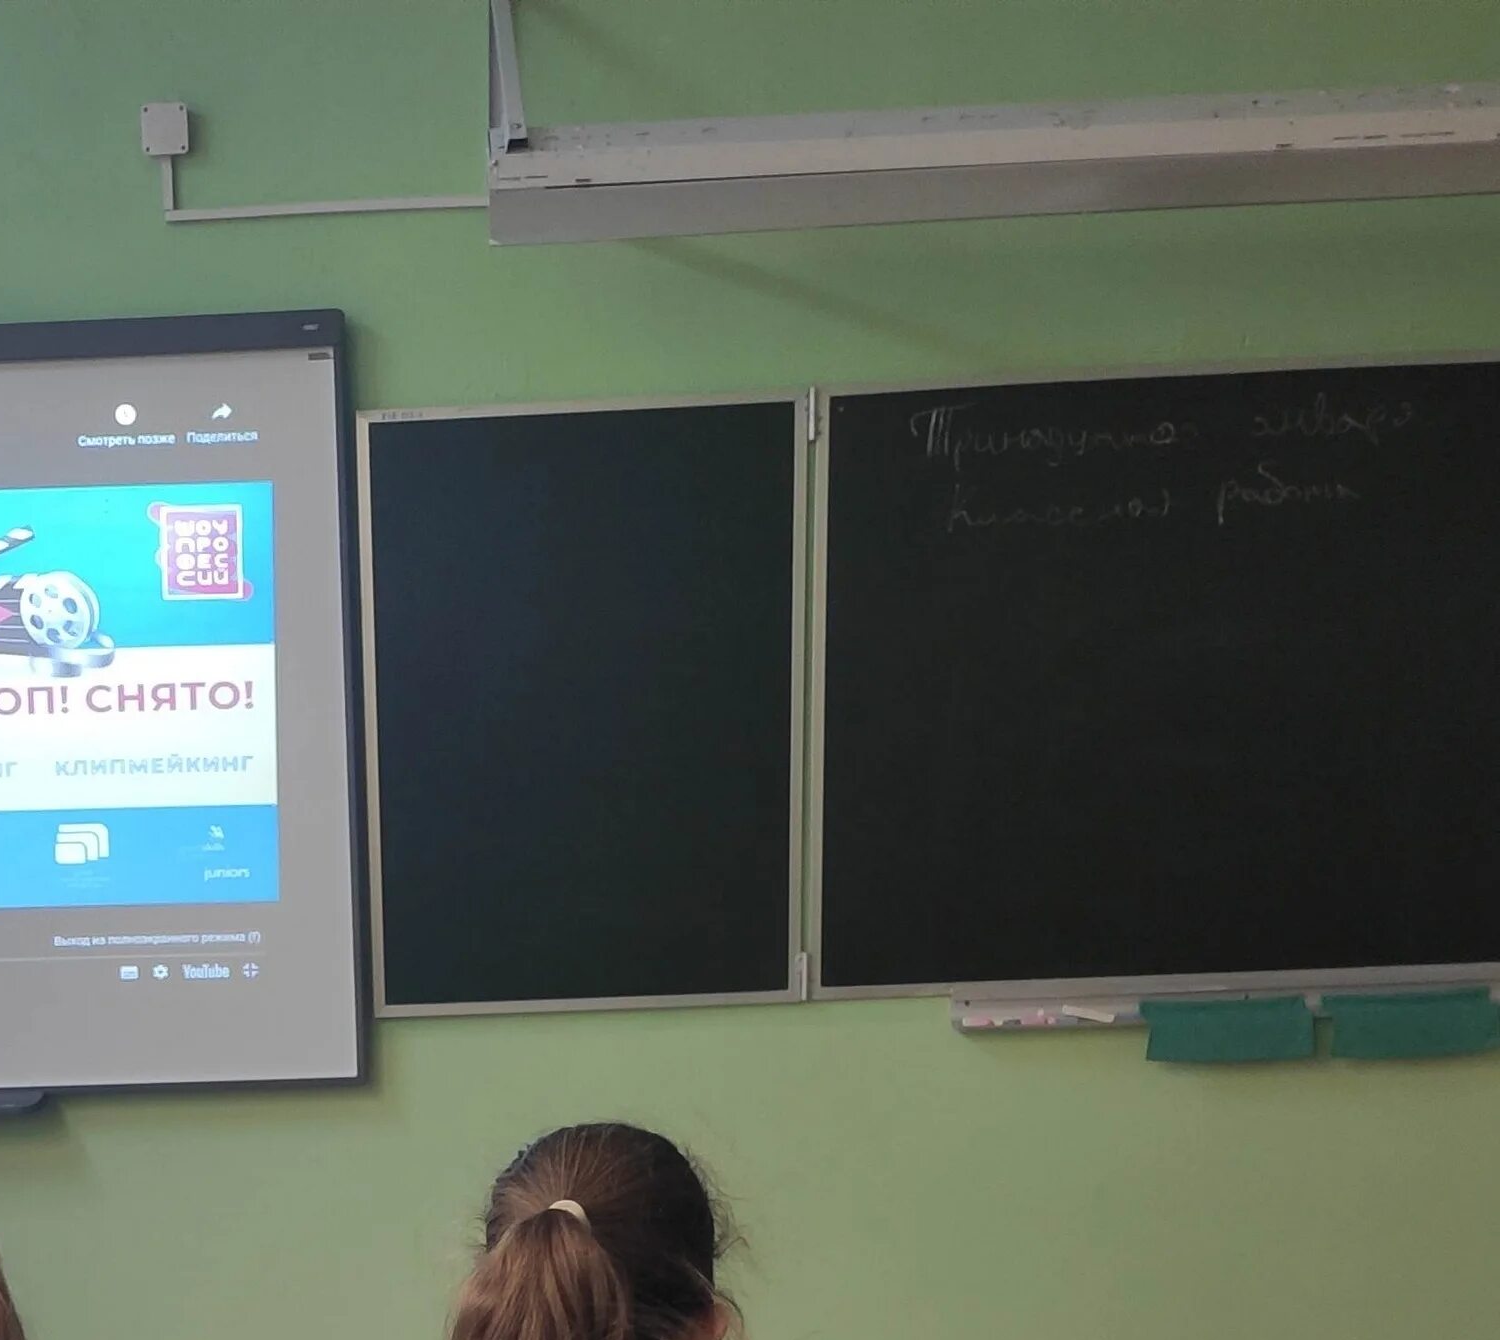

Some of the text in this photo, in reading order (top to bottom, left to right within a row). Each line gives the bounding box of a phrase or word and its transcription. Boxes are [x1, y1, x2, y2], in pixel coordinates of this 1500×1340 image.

[187, 431, 258, 444] Поделиться
[86, 681, 254, 713] СНЯТО!
[55, 754, 254, 777] КЛИПМЕЙКИНГ
[183, 963, 230, 979] YouTube
